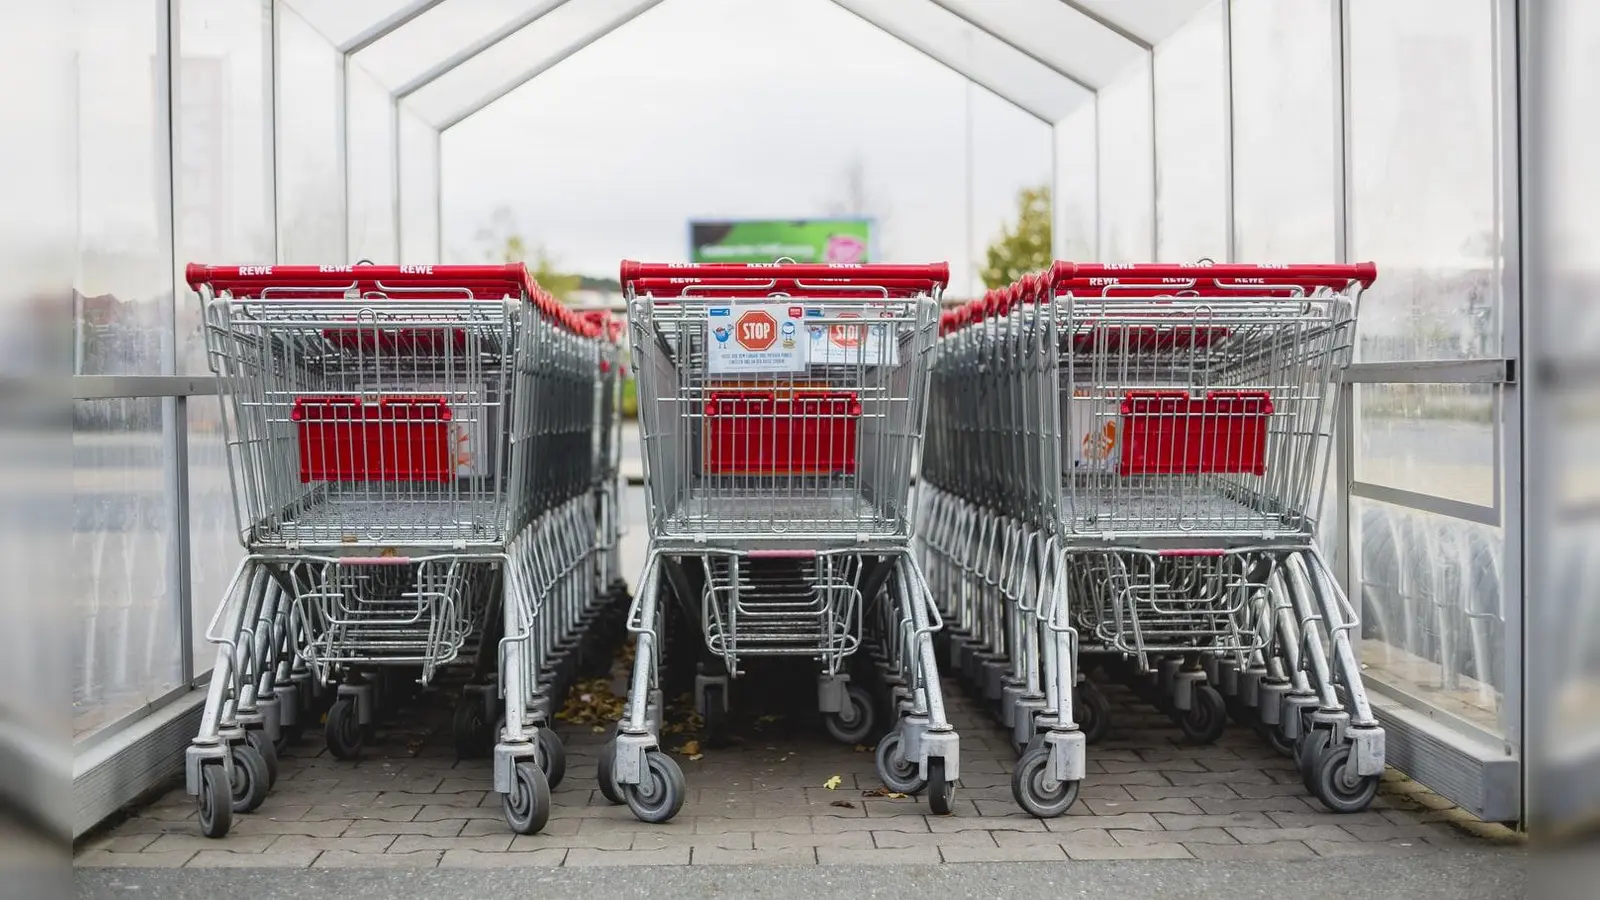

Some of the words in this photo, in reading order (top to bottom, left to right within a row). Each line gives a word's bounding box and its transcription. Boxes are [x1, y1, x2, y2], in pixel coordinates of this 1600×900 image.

[239, 266, 272, 275] REWE
[319, 264, 353, 273] REWE
[400, 265, 433, 274] REWE
[1089, 277, 1119, 286] REWE
[742, 323, 770, 340] STOP
